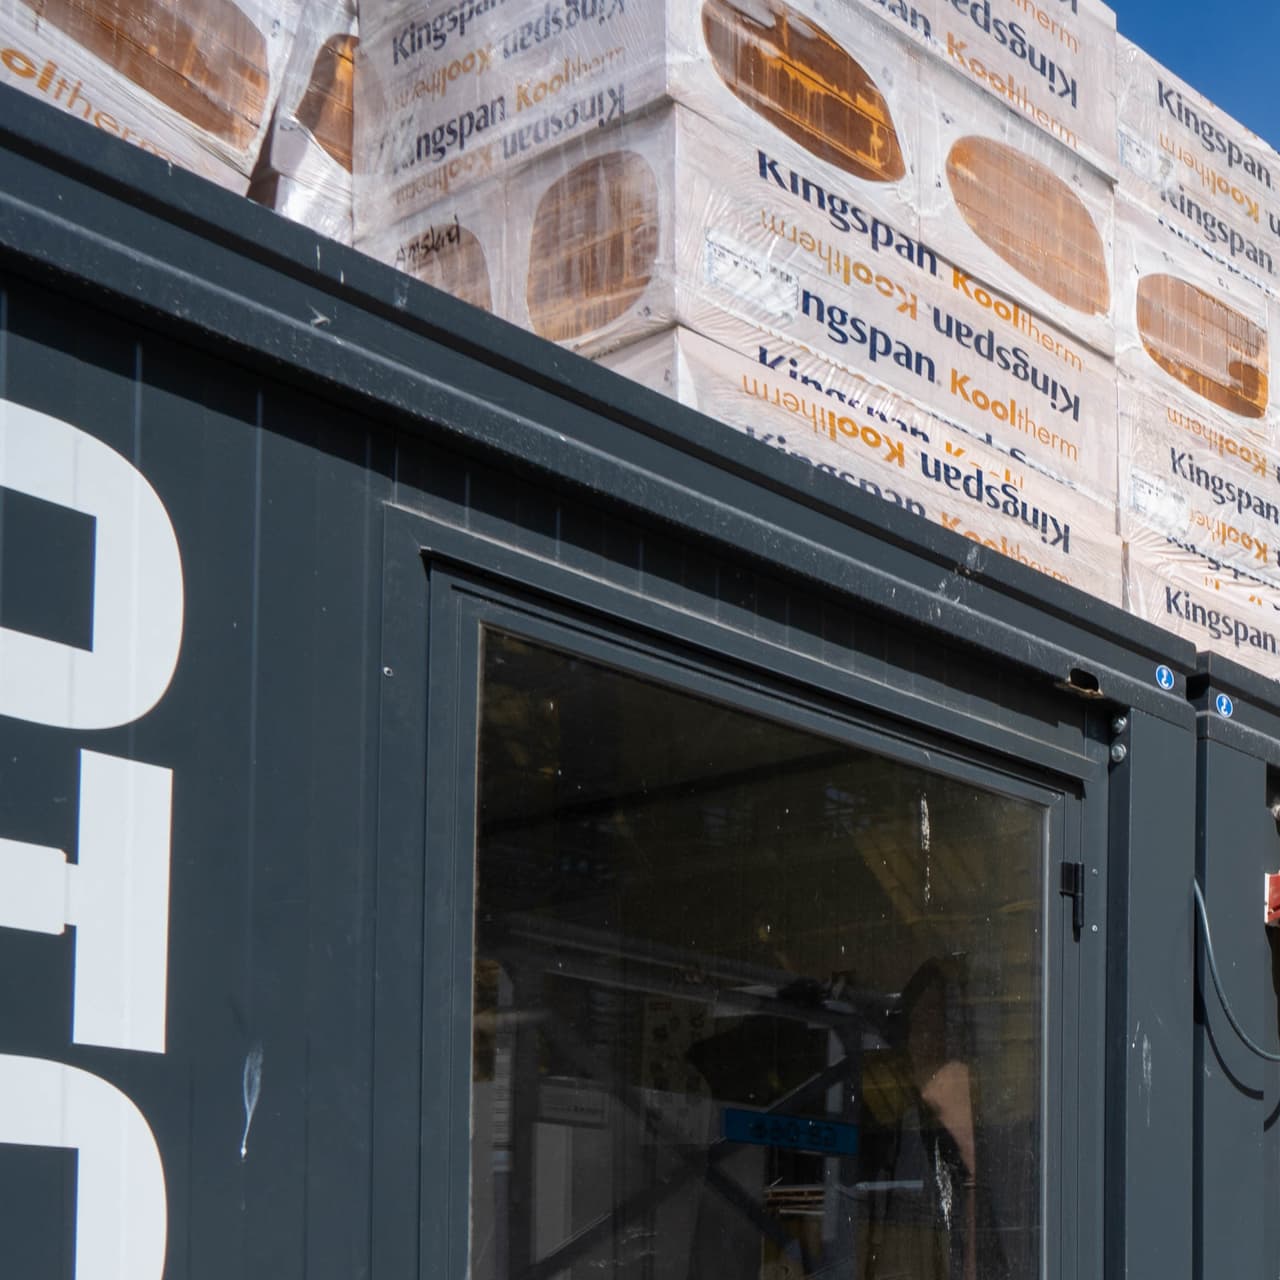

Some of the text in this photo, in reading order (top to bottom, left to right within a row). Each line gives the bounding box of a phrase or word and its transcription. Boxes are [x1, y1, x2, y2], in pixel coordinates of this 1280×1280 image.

[945, 0, 1078, 109] Kingspa
[946, 31, 1080, 150] Kooltherm
[394, 96, 506, 173] ngspan
[1156, 79, 1273, 189] Kingspan
[1159, 132, 1260, 225] Kooltherm
[757, 149, 1084, 372] Kingspan Kooltherm
[760, 209, 918, 320] Kooltherm
[1161, 186, 1274, 276] Kingspan
[801, 288, 936, 383] ngspan
[950, 367, 1079, 462] Kooltherm
[932, 305, 1080, 423] Kingspan
[742, 375, 905, 468] Kooltherm
[1167, 406, 1267, 479] Kooltherm
[920, 451, 1070, 555] Kingspan
[1170, 446, 1280, 526] Kingspan
[1190, 507, 1268, 564] Koolther
[1165, 585, 1277, 655] Kingspan
